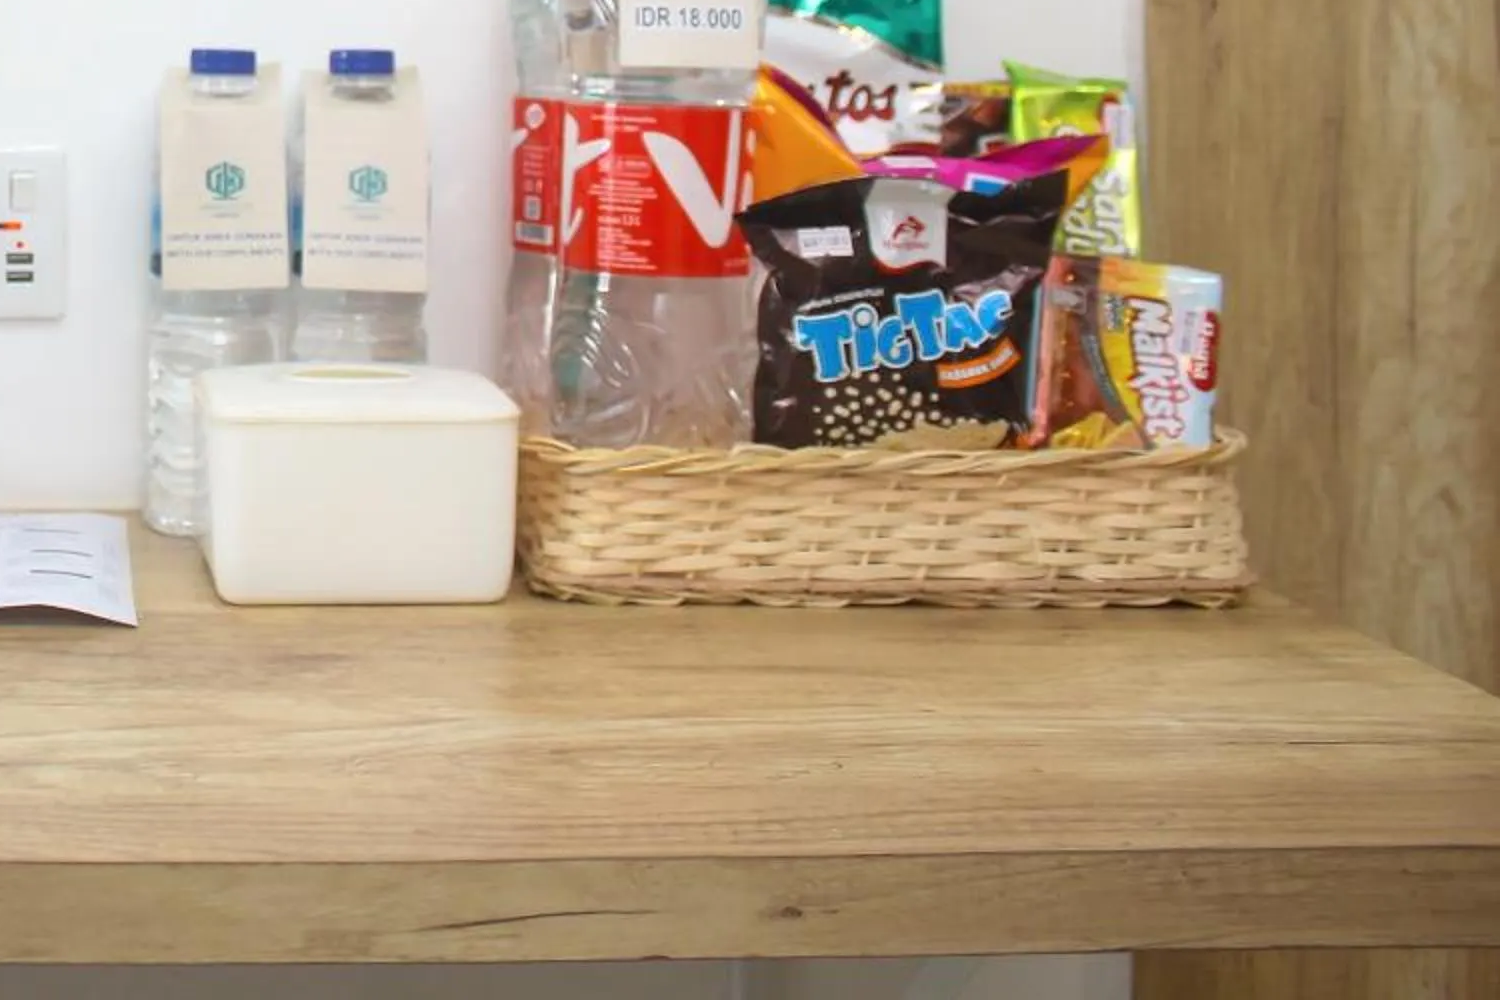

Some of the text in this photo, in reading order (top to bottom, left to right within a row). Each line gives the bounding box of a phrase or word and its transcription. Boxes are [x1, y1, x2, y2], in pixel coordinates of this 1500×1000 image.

[634, 6, 743, 30] IDR 18.000
[1124, 294, 1192, 440] Malkist
